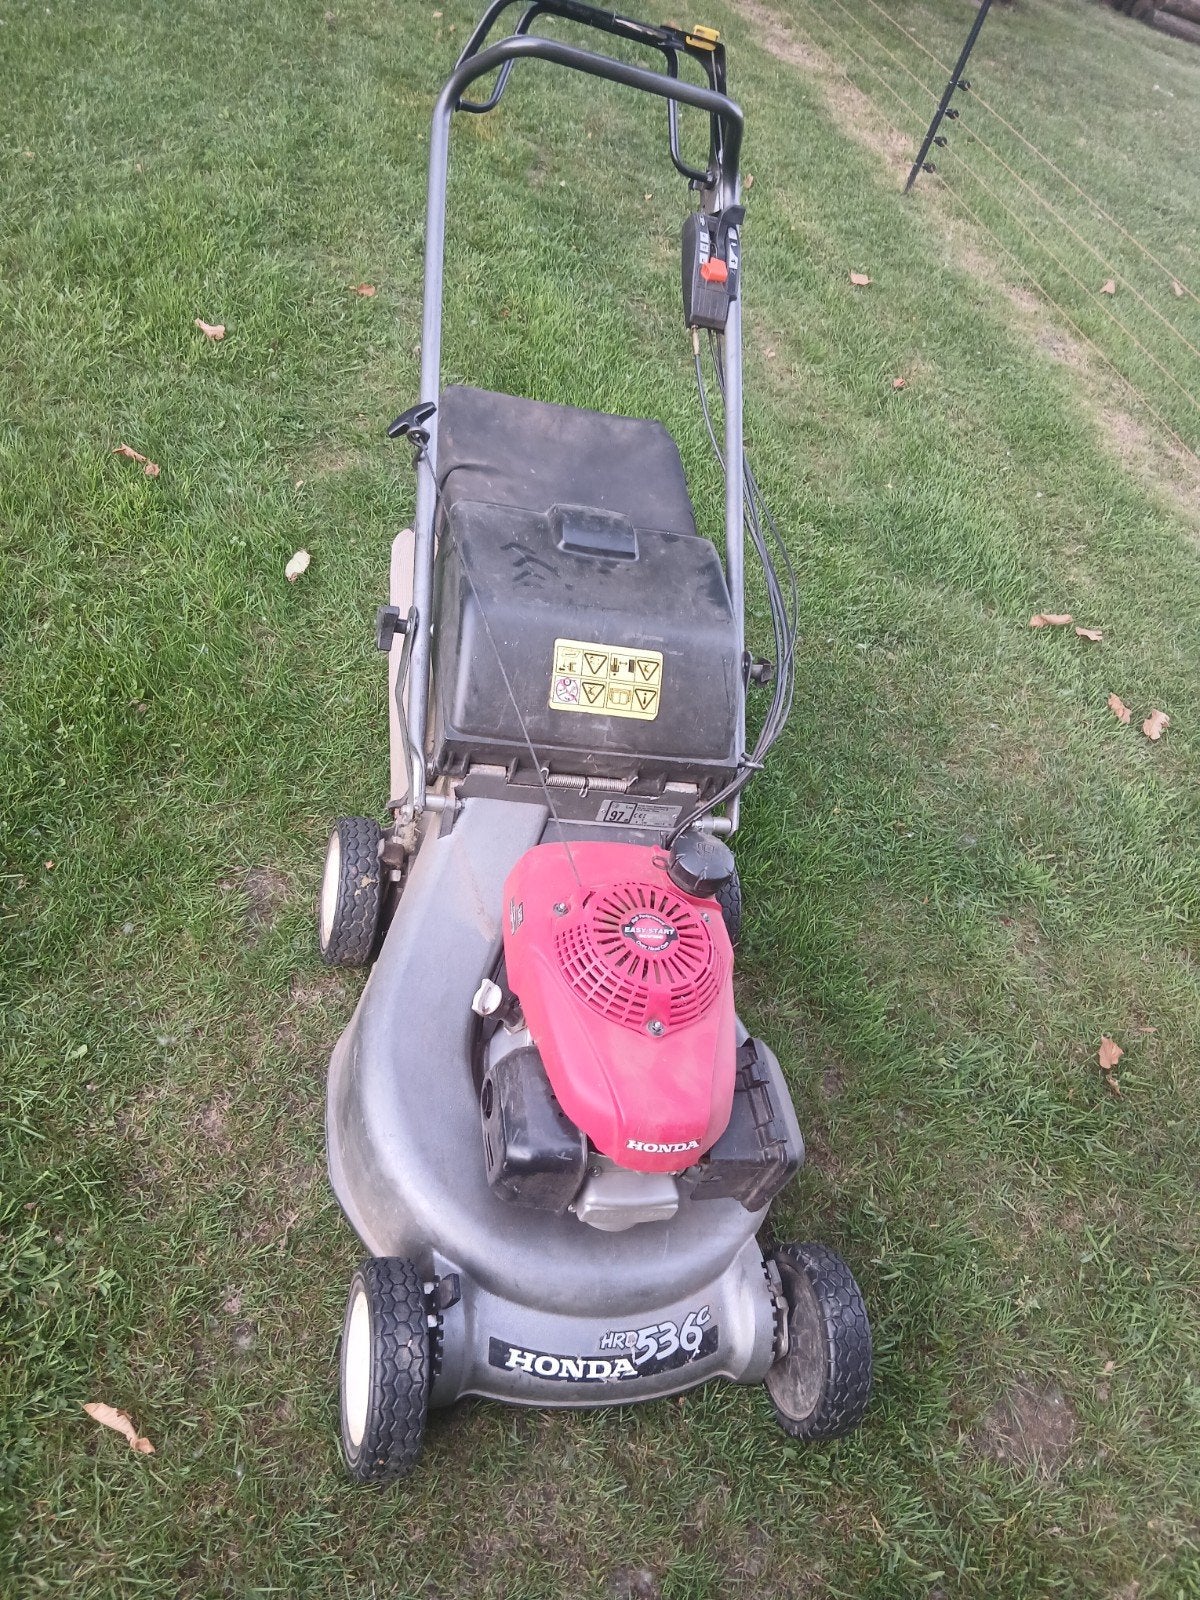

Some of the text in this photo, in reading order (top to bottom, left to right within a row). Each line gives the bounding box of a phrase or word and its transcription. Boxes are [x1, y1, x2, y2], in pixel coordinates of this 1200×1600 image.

[609, 810, 625, 821] 97
[648, 927, 675, 936] START
[626, 1139, 700, 1153] HONDA
[504, 1347, 638, 1379] HONDA
